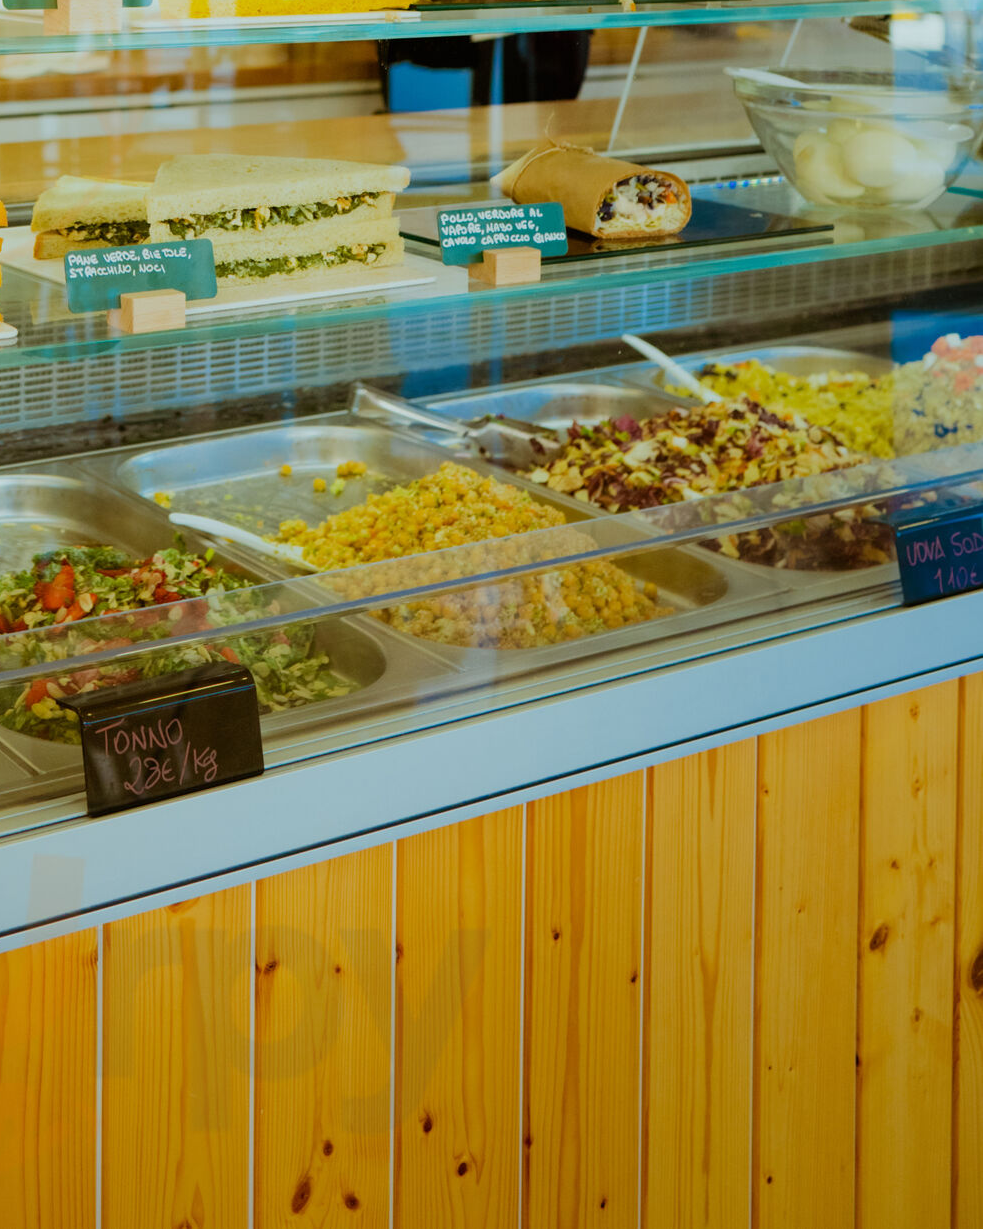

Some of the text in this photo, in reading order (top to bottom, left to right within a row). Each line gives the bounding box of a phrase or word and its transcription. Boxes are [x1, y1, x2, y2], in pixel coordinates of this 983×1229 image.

[440, 207, 543, 226] POLLO, VERDURE AL
[441, 220, 540, 236] VAPORE, MAYO VEG,
[442, 232, 567, 248] CAVOLO CAPPUCCIO BIANCO
[67, 254, 99, 268] PANE
[103, 250, 141, 263] VERDE,
[69, 263, 166, 279] STRACCHINO, NOCI
[906, 535, 946, 567] UOVA
[95, 717, 184, 757] TONNO
